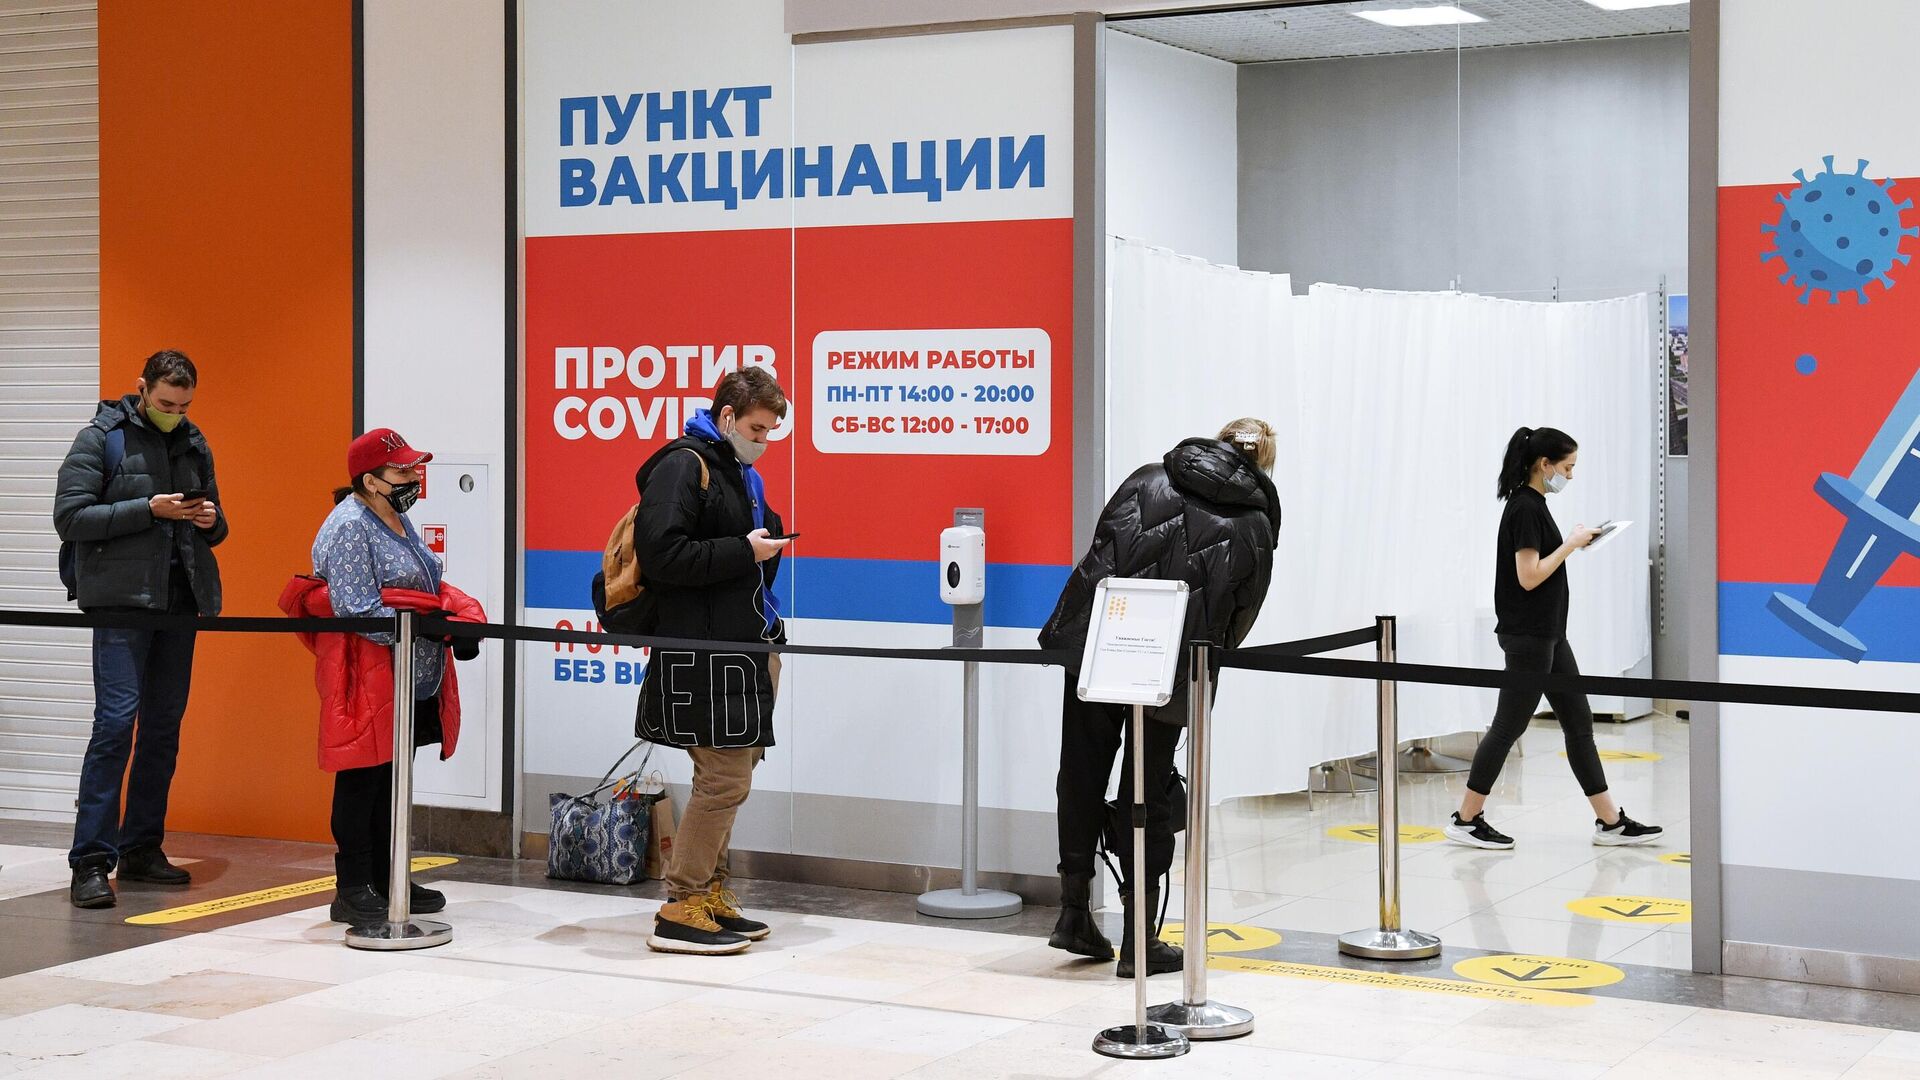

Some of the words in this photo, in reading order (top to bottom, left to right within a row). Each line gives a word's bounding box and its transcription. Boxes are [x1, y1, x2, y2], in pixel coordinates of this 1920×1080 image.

[559, 85, 772, 146] ПУНКТ
[559, 134, 1046, 211] ВАКЦИНАЦИИ
[554, 344, 778, 389] ПРОТИВ
[827, 350, 919, 370] РЕЖИМ
[926, 349, 1035, 369] РАБОТЫ
[827, 385, 893, 402] ПН-ПТ
[898, 384, 955, 403] 14:00
[973, 384, 1035, 403] 20:00
[831, 416, 896, 434] СБ-ВС
[900, 416, 955, 434] 12:00
[973, 416, 1030, 434] 17:00
[554, 658, 606, 684] БЕЗ
